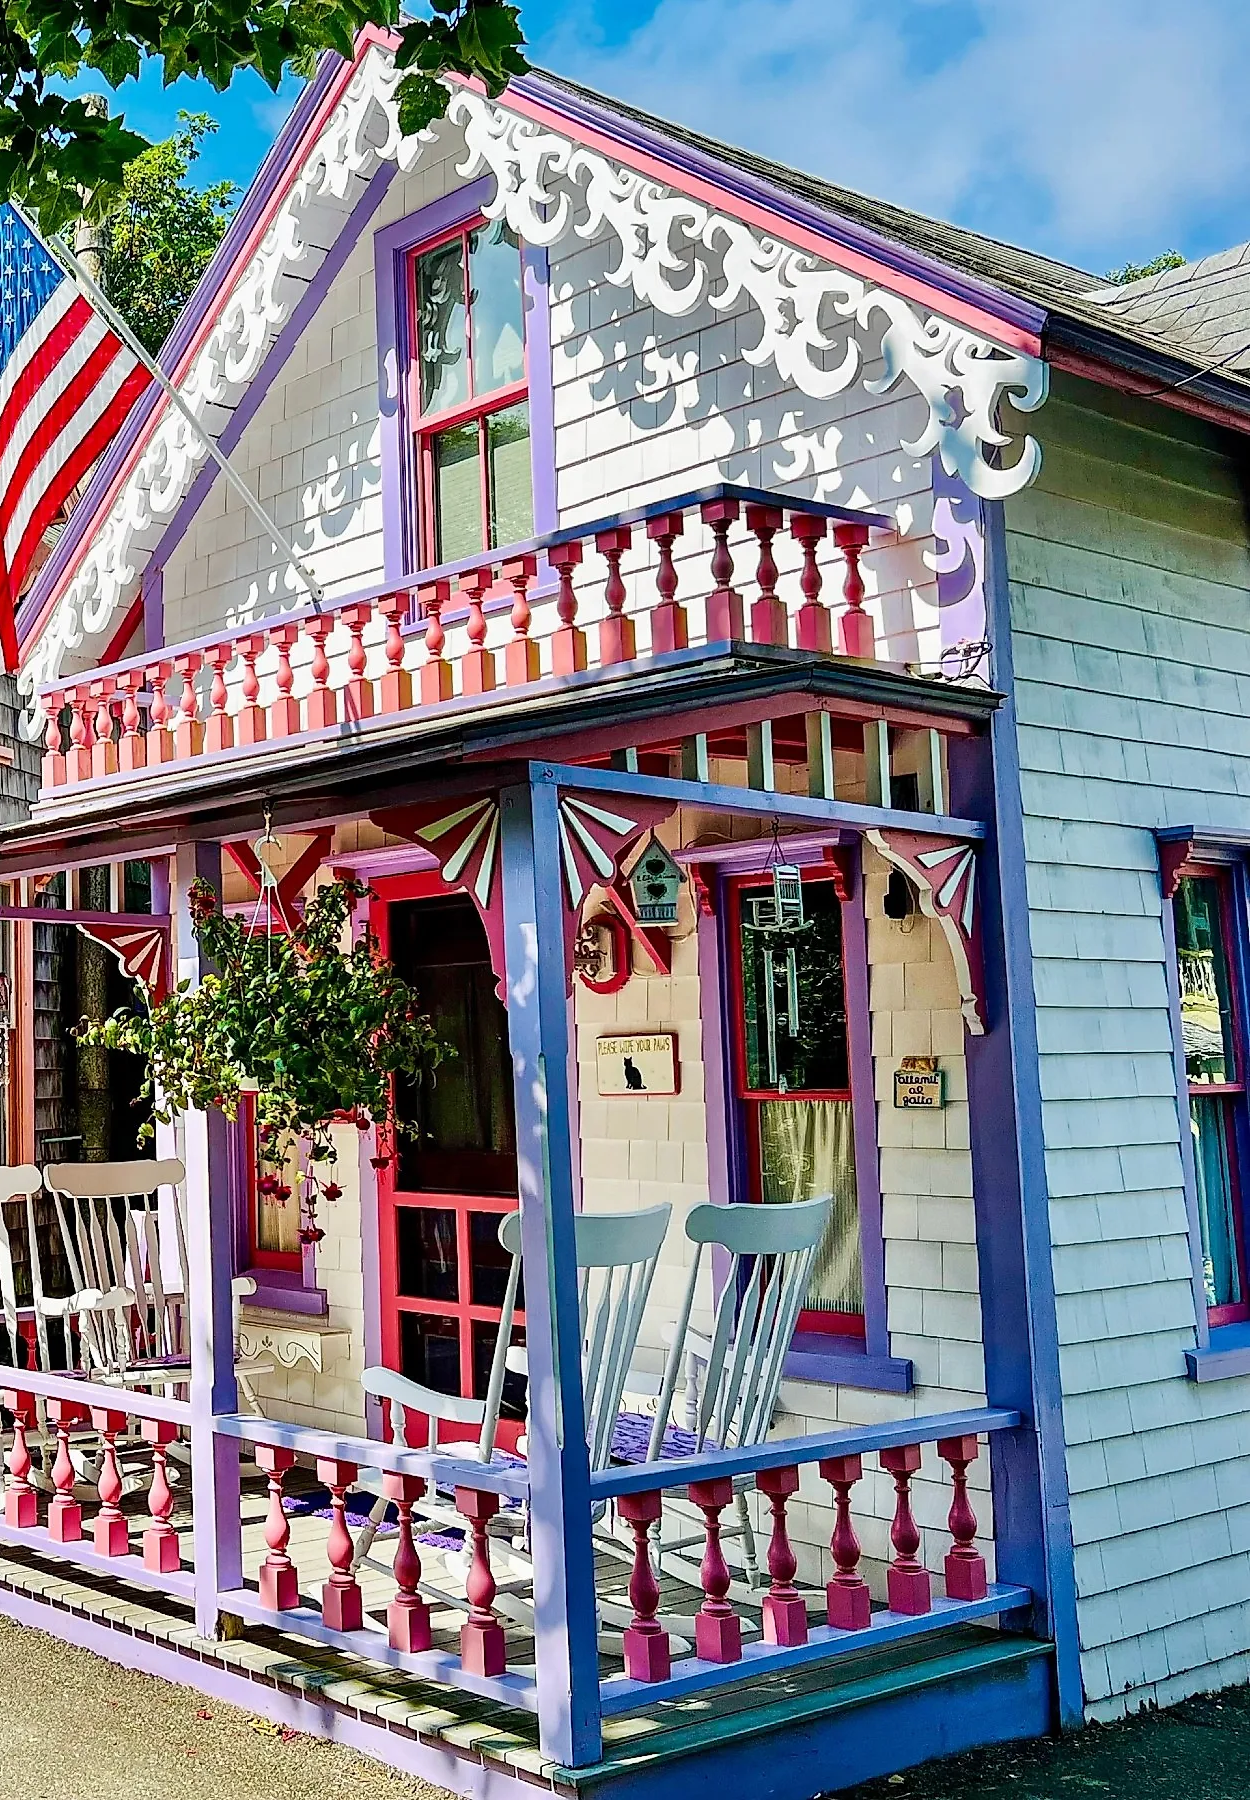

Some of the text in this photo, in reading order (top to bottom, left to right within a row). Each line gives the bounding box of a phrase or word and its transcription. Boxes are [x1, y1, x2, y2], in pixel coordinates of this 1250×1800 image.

[598, 1037, 670, 1055] PLEASE WIPE YOUR PAWS
